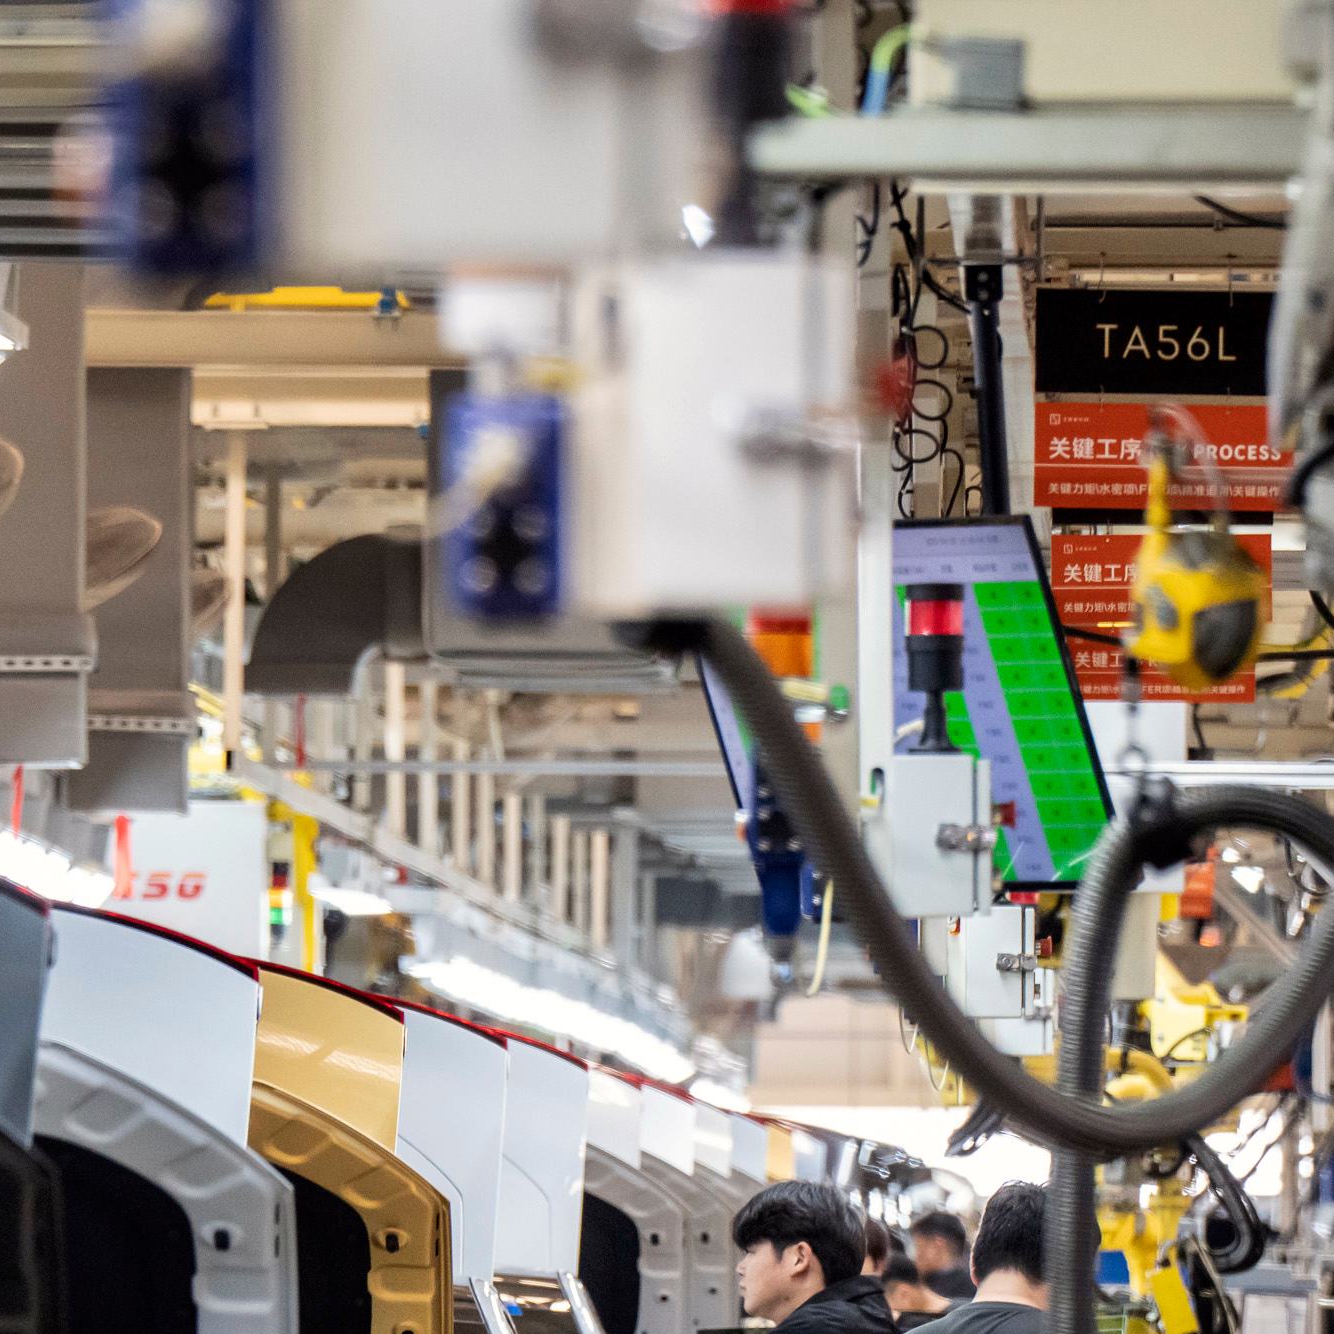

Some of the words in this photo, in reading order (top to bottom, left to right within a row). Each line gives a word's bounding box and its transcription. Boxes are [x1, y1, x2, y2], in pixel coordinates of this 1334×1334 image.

[1095, 323, 1237, 361] TA56L
[1049, 437, 1142, 461] 关键工序
[1193, 444, 1281, 461] PROCESS
[1075, 652, 1124, 668] 关键工
